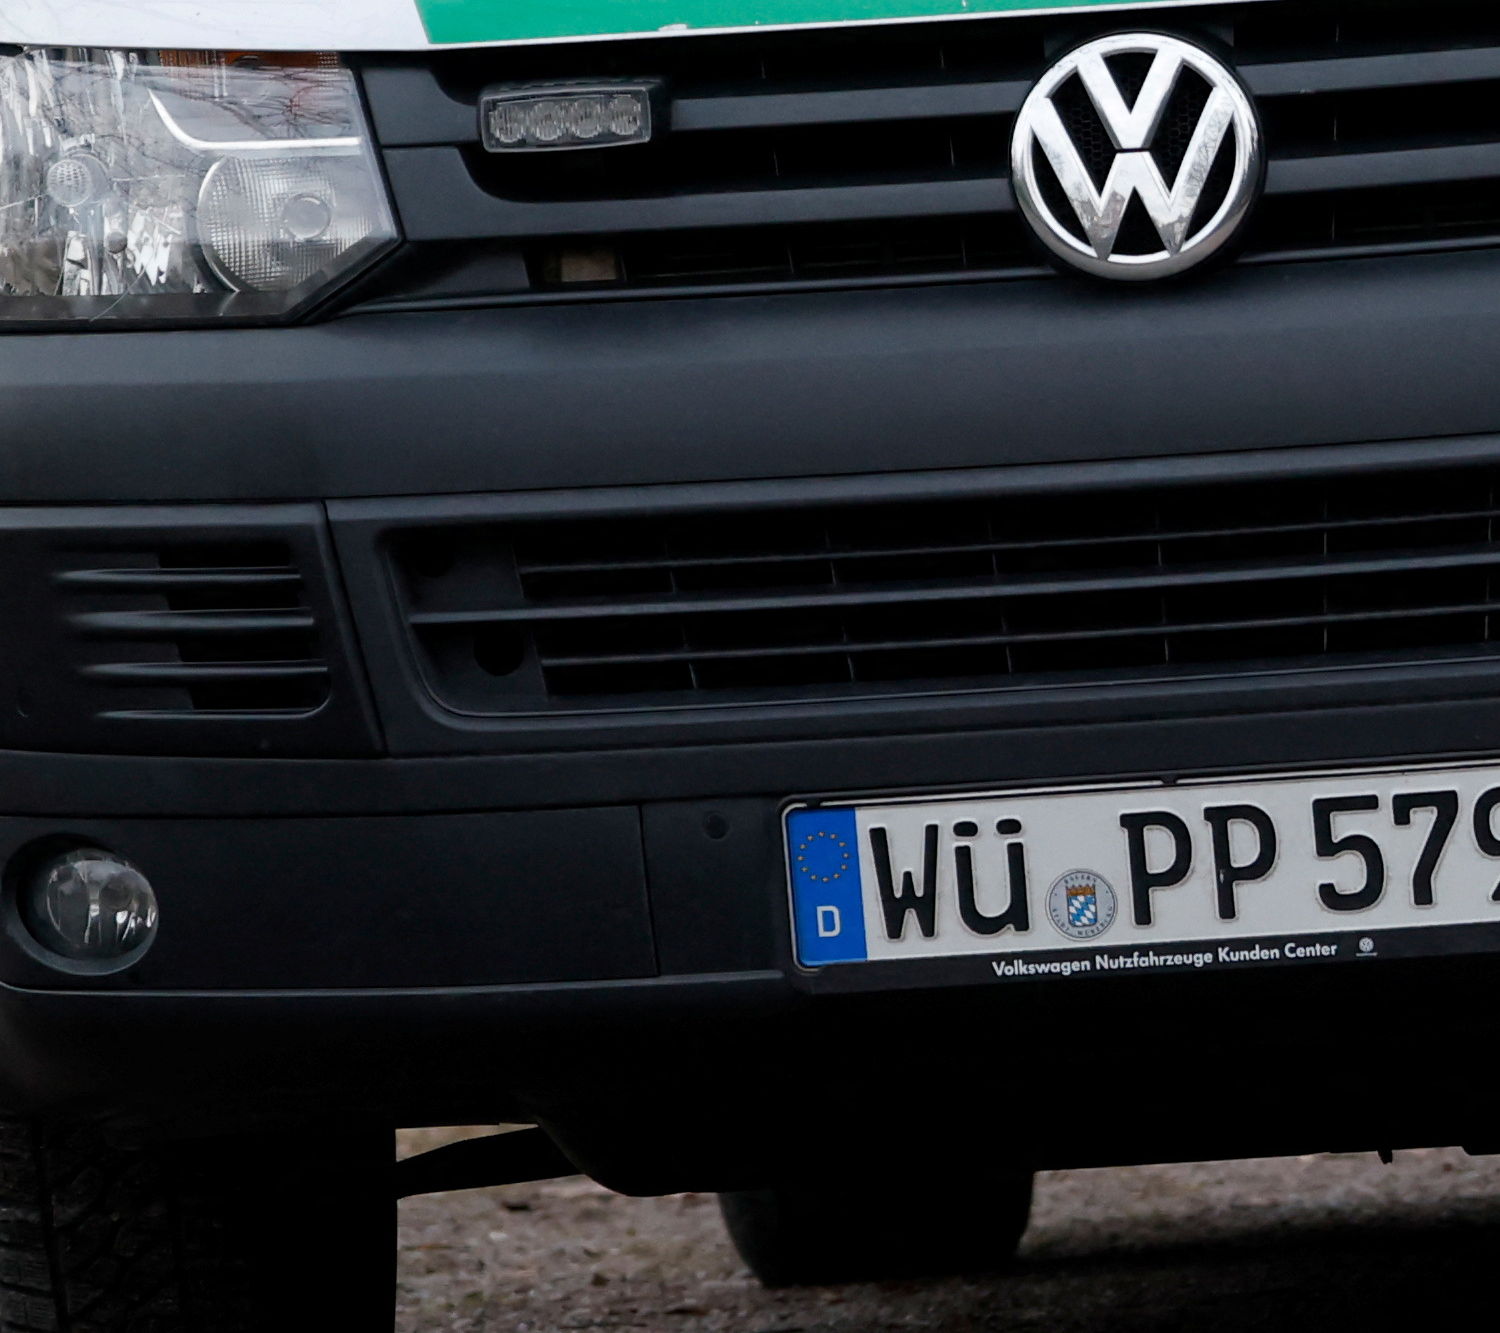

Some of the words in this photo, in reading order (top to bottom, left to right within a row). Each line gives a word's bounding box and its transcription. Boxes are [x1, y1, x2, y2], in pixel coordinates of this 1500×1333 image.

[868, 820, 1030, 940] WÜ
[1119, 804, 1277, 926] PP
[817, 906, 841, 937] D
[991, 959, 1091, 977] Volkswagen
[1096, 950, 1213, 968] Nutzfahrzeuge
[1218, 944, 1280, 962] Kunden
[1284, 942, 1338, 958] Center
